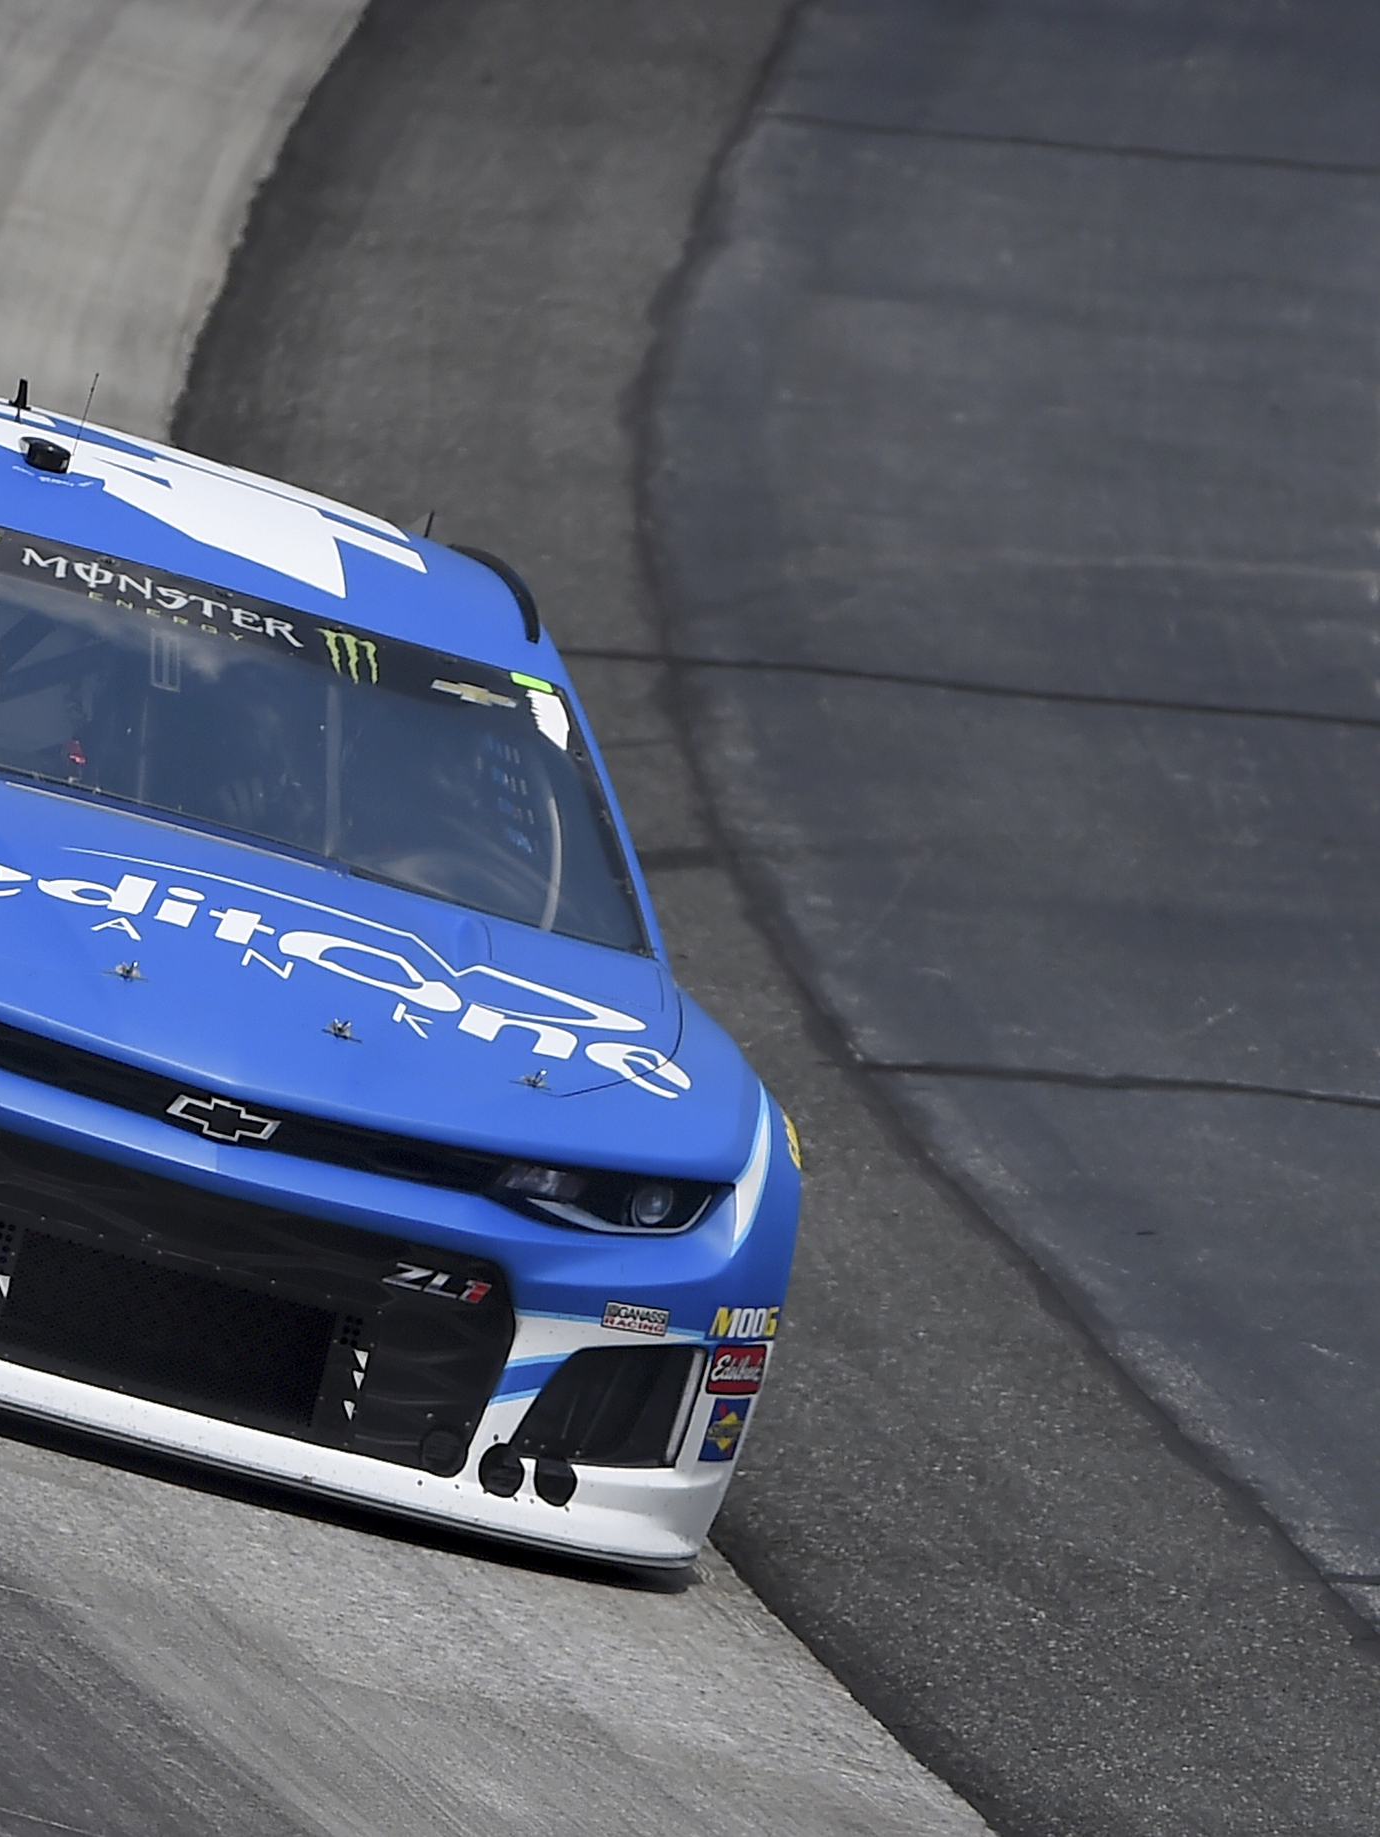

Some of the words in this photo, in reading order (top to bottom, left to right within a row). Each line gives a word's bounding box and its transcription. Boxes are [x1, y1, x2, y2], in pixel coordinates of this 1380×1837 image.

[88, 591, 244, 641] ENERGY
[603, 1315, 666, 1333] RACING
[709, 1306, 780, 1339] MOOG
